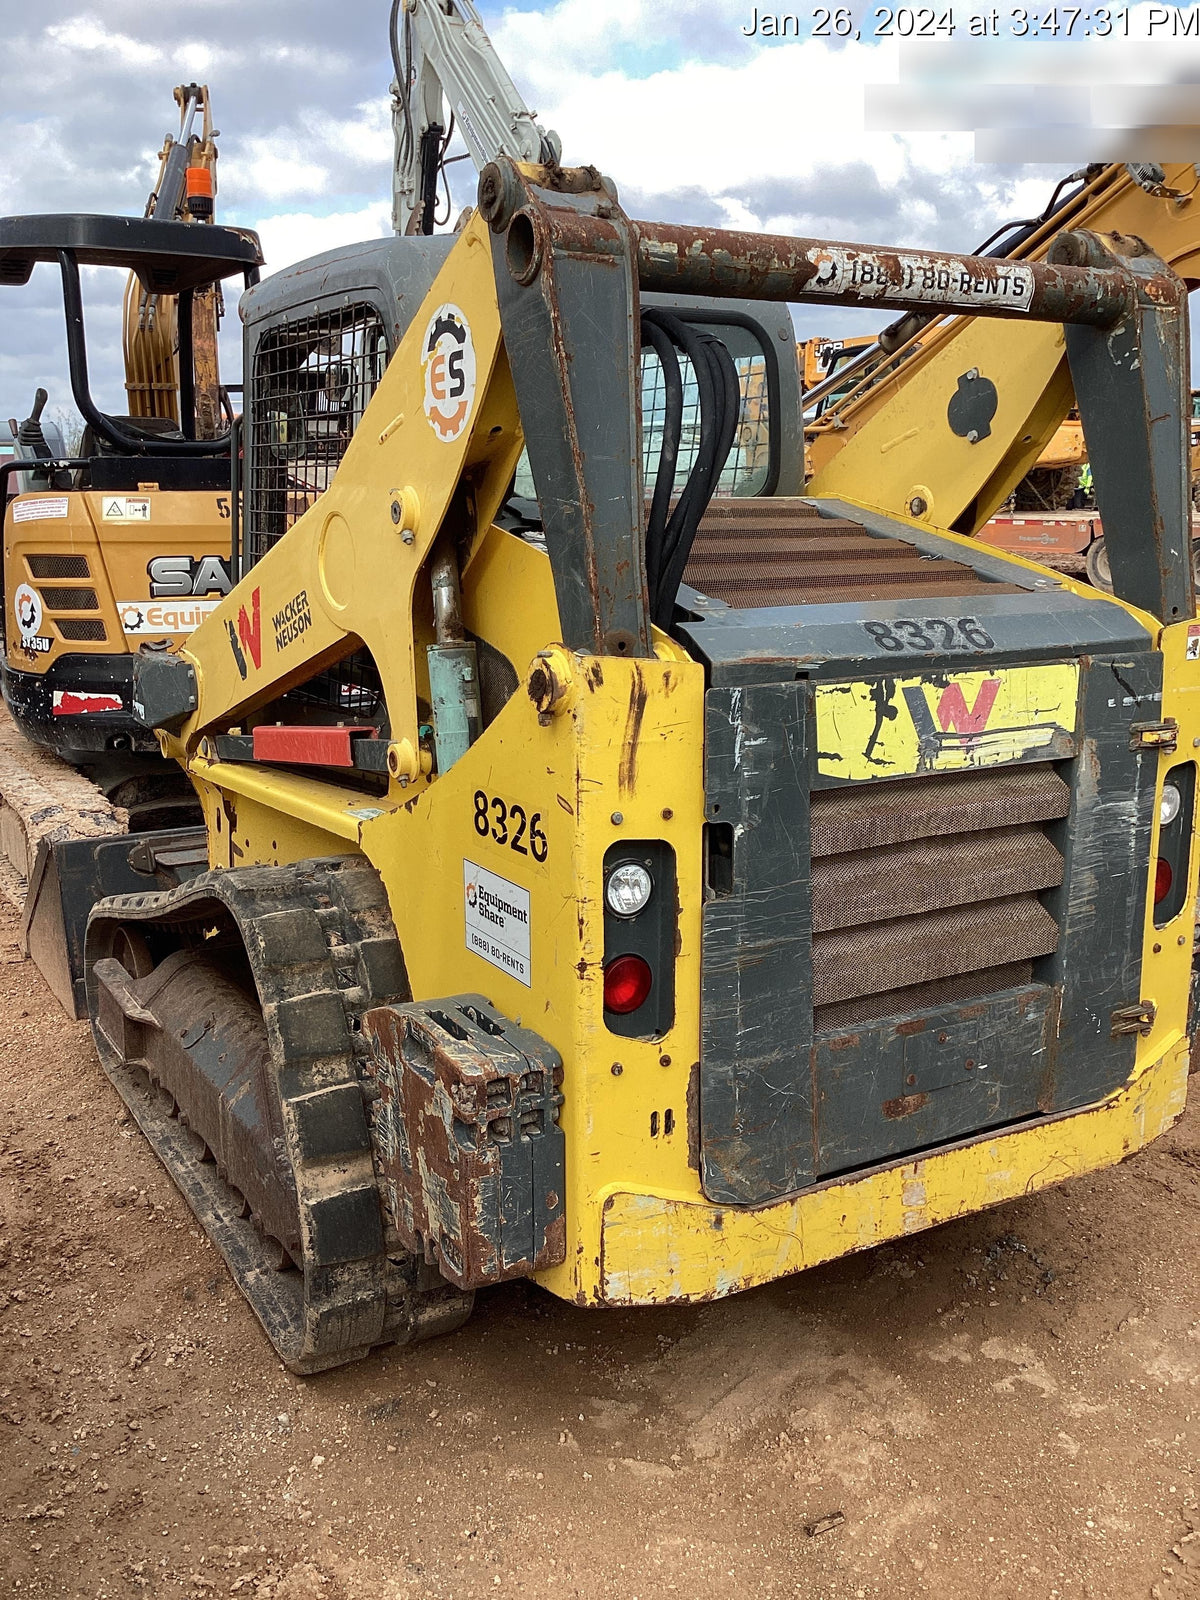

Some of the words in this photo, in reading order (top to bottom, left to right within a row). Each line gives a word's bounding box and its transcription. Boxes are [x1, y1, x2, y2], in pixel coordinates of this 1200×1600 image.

[149, 555, 243, 598] SA
[272, 589, 309, 633] WACKER
[275, 608, 312, 653] NEUSON
[864, 617, 995, 651] 8326
[473, 789, 549, 863] 8326
[478, 884, 528, 925] Equipment
[478, 903, 505, 928] Share
[471, 931, 490, 954] (888)
[490, 944, 525, 975] 80-RENTS
